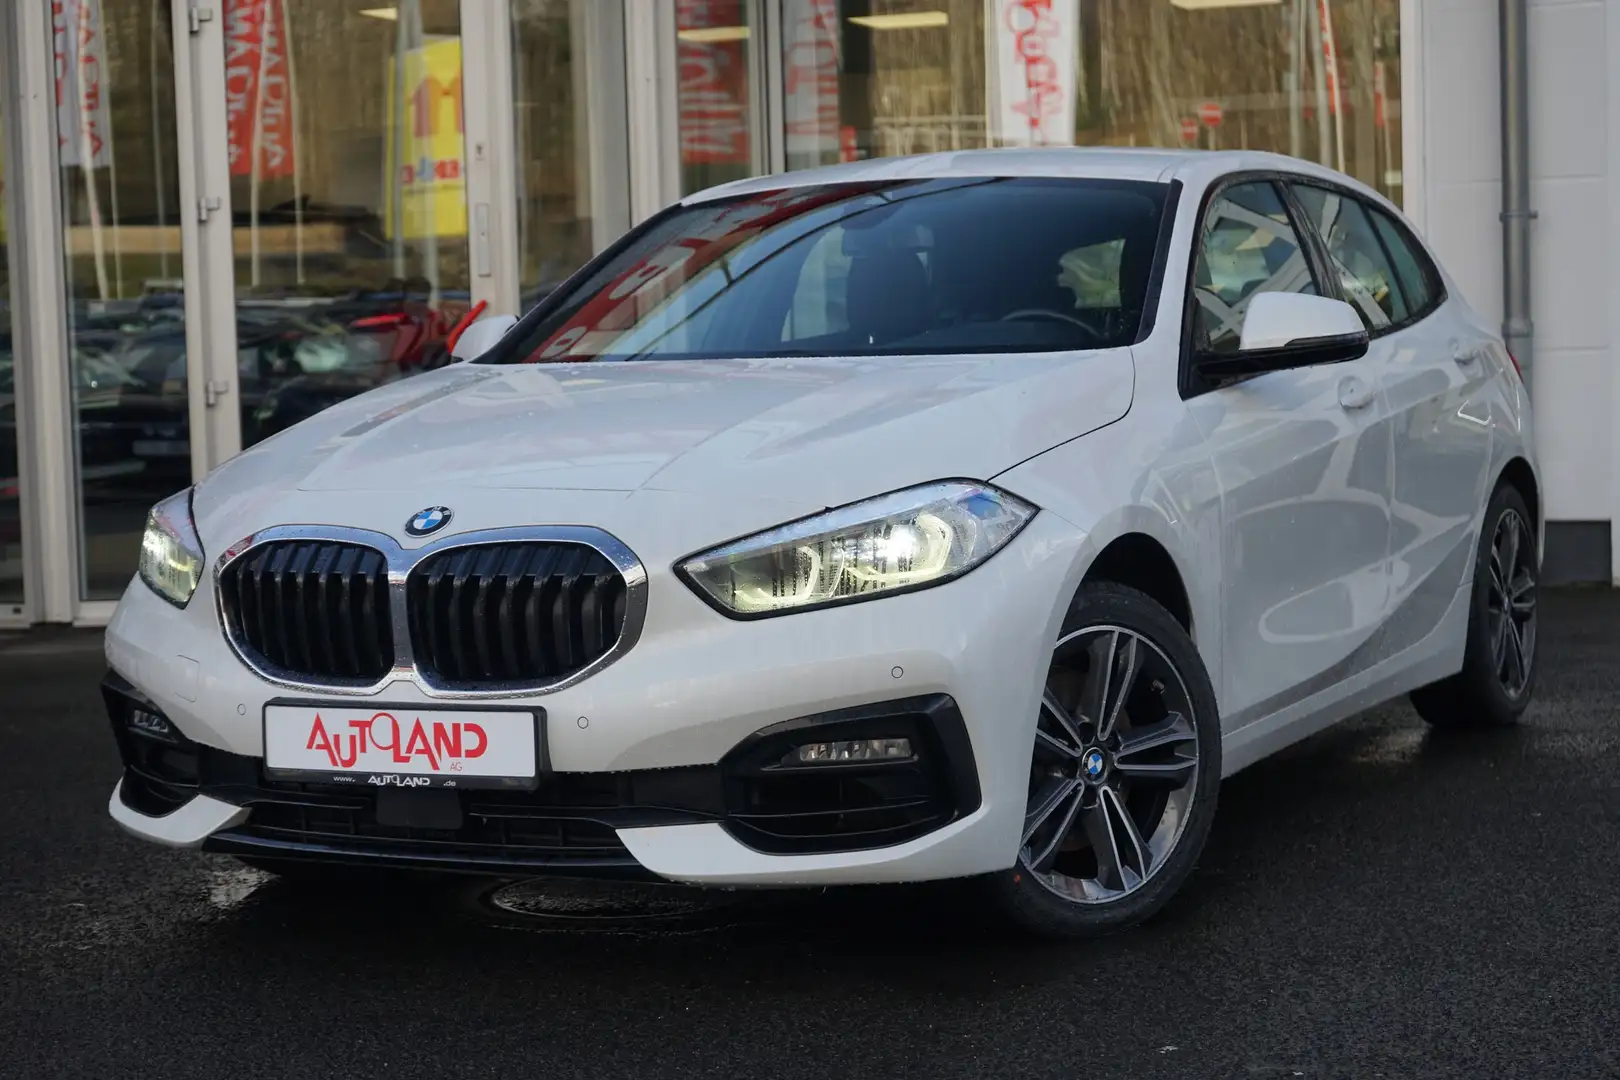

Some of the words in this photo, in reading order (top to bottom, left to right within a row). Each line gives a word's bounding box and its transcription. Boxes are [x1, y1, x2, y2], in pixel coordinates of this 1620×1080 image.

[306, 712, 488, 771] AUTOLAND
[450, 761, 463, 772] AG
[333, 775, 356, 783] www.
[368, 774, 431, 788] AUTOLAND
[443, 779, 456, 787] .de
